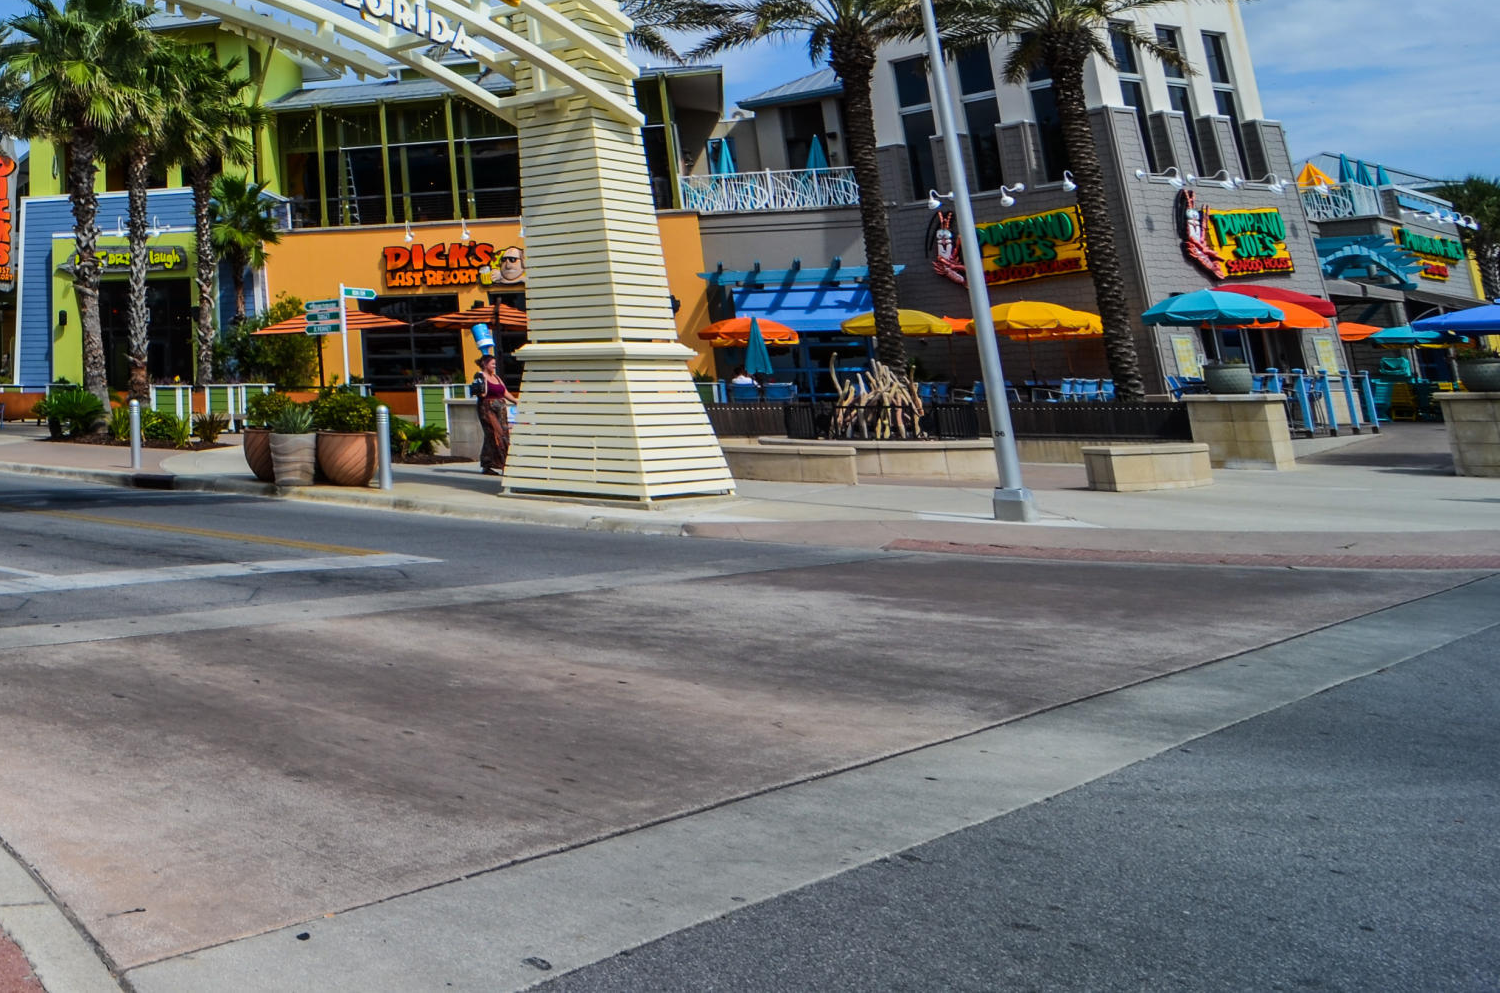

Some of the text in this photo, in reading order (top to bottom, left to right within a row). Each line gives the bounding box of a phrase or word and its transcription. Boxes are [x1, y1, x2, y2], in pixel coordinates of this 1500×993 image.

[1213, 212, 1286, 246] POMPANO
[149, 247, 181, 269] laugh
[384, 241, 494, 271] DICK'S
[386, 268, 479, 287] LAST RESORT
